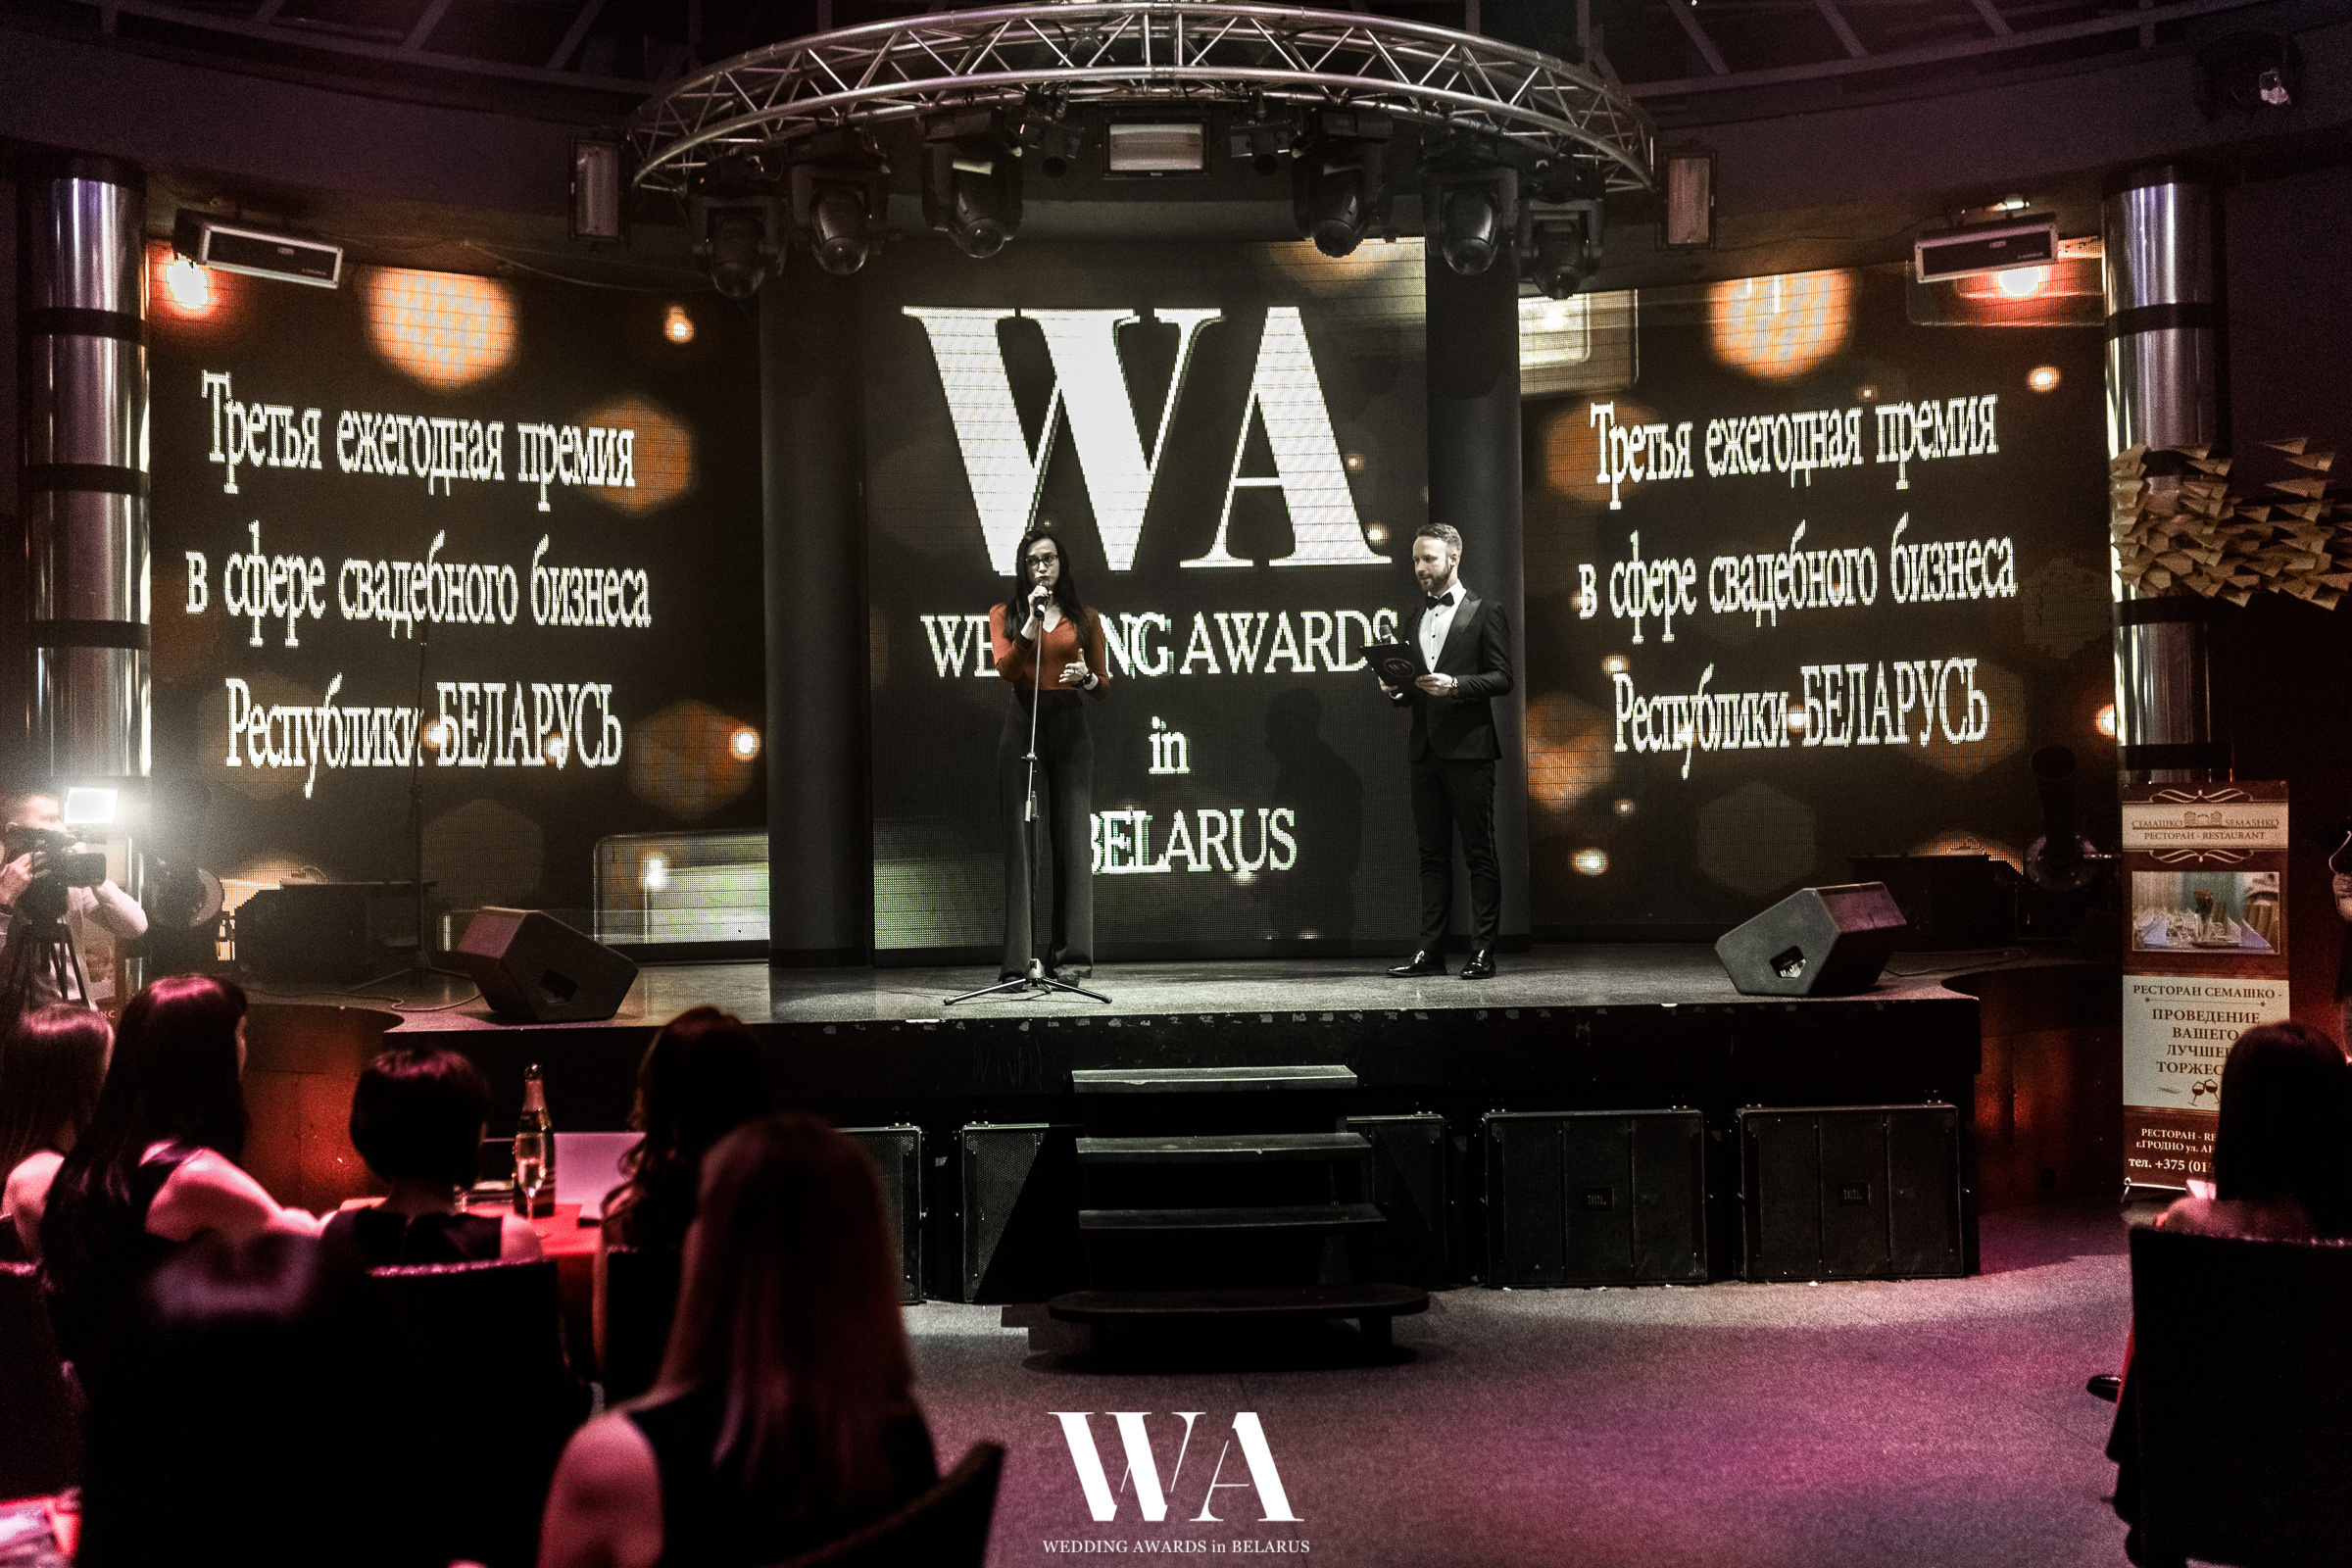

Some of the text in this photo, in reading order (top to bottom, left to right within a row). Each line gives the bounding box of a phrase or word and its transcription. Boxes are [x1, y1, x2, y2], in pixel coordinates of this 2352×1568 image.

[202, 370, 635, 511] Третья ежегодная премия
[902, 306, 1393, 575] WA
[1591, 394, 1998, 510] Третья ежегодная премия
[186, 520, 651, 647] в сфере свадебного бизнеса
[1579, 513, 2017, 643] в сфере свадебного бизнеса
[920, 612, 1174, 678] WENG
[225, 674, 622, 798] Республики БЕЛАРУСЬ
[1149, 716, 1190, 774] in
[1613, 658, 1989, 779] Республики БЕЛАРУСЬ
[2144, 831, 2266, 840] РЕСТОРАН RESTAURANT
[2226, 818, 2279, 828] SEMASHKO
[2133, 984, 2201, 997] РЕСТОРАН
[2205, 987, 2276, 999] СЕМАШКО
[2152, 1008, 2261, 1024] ПРОВЕДЕНИЕ
[2173, 1027, 2239, 1041] ВАШЕГО
[2141, 1128, 2195, 1141] РЕСТОРАН
[2185, 1145, 2199, 1153] ул.
[2128, 1158, 2152, 1168] тел.
[2155, 1158, 2185, 1171] +375
